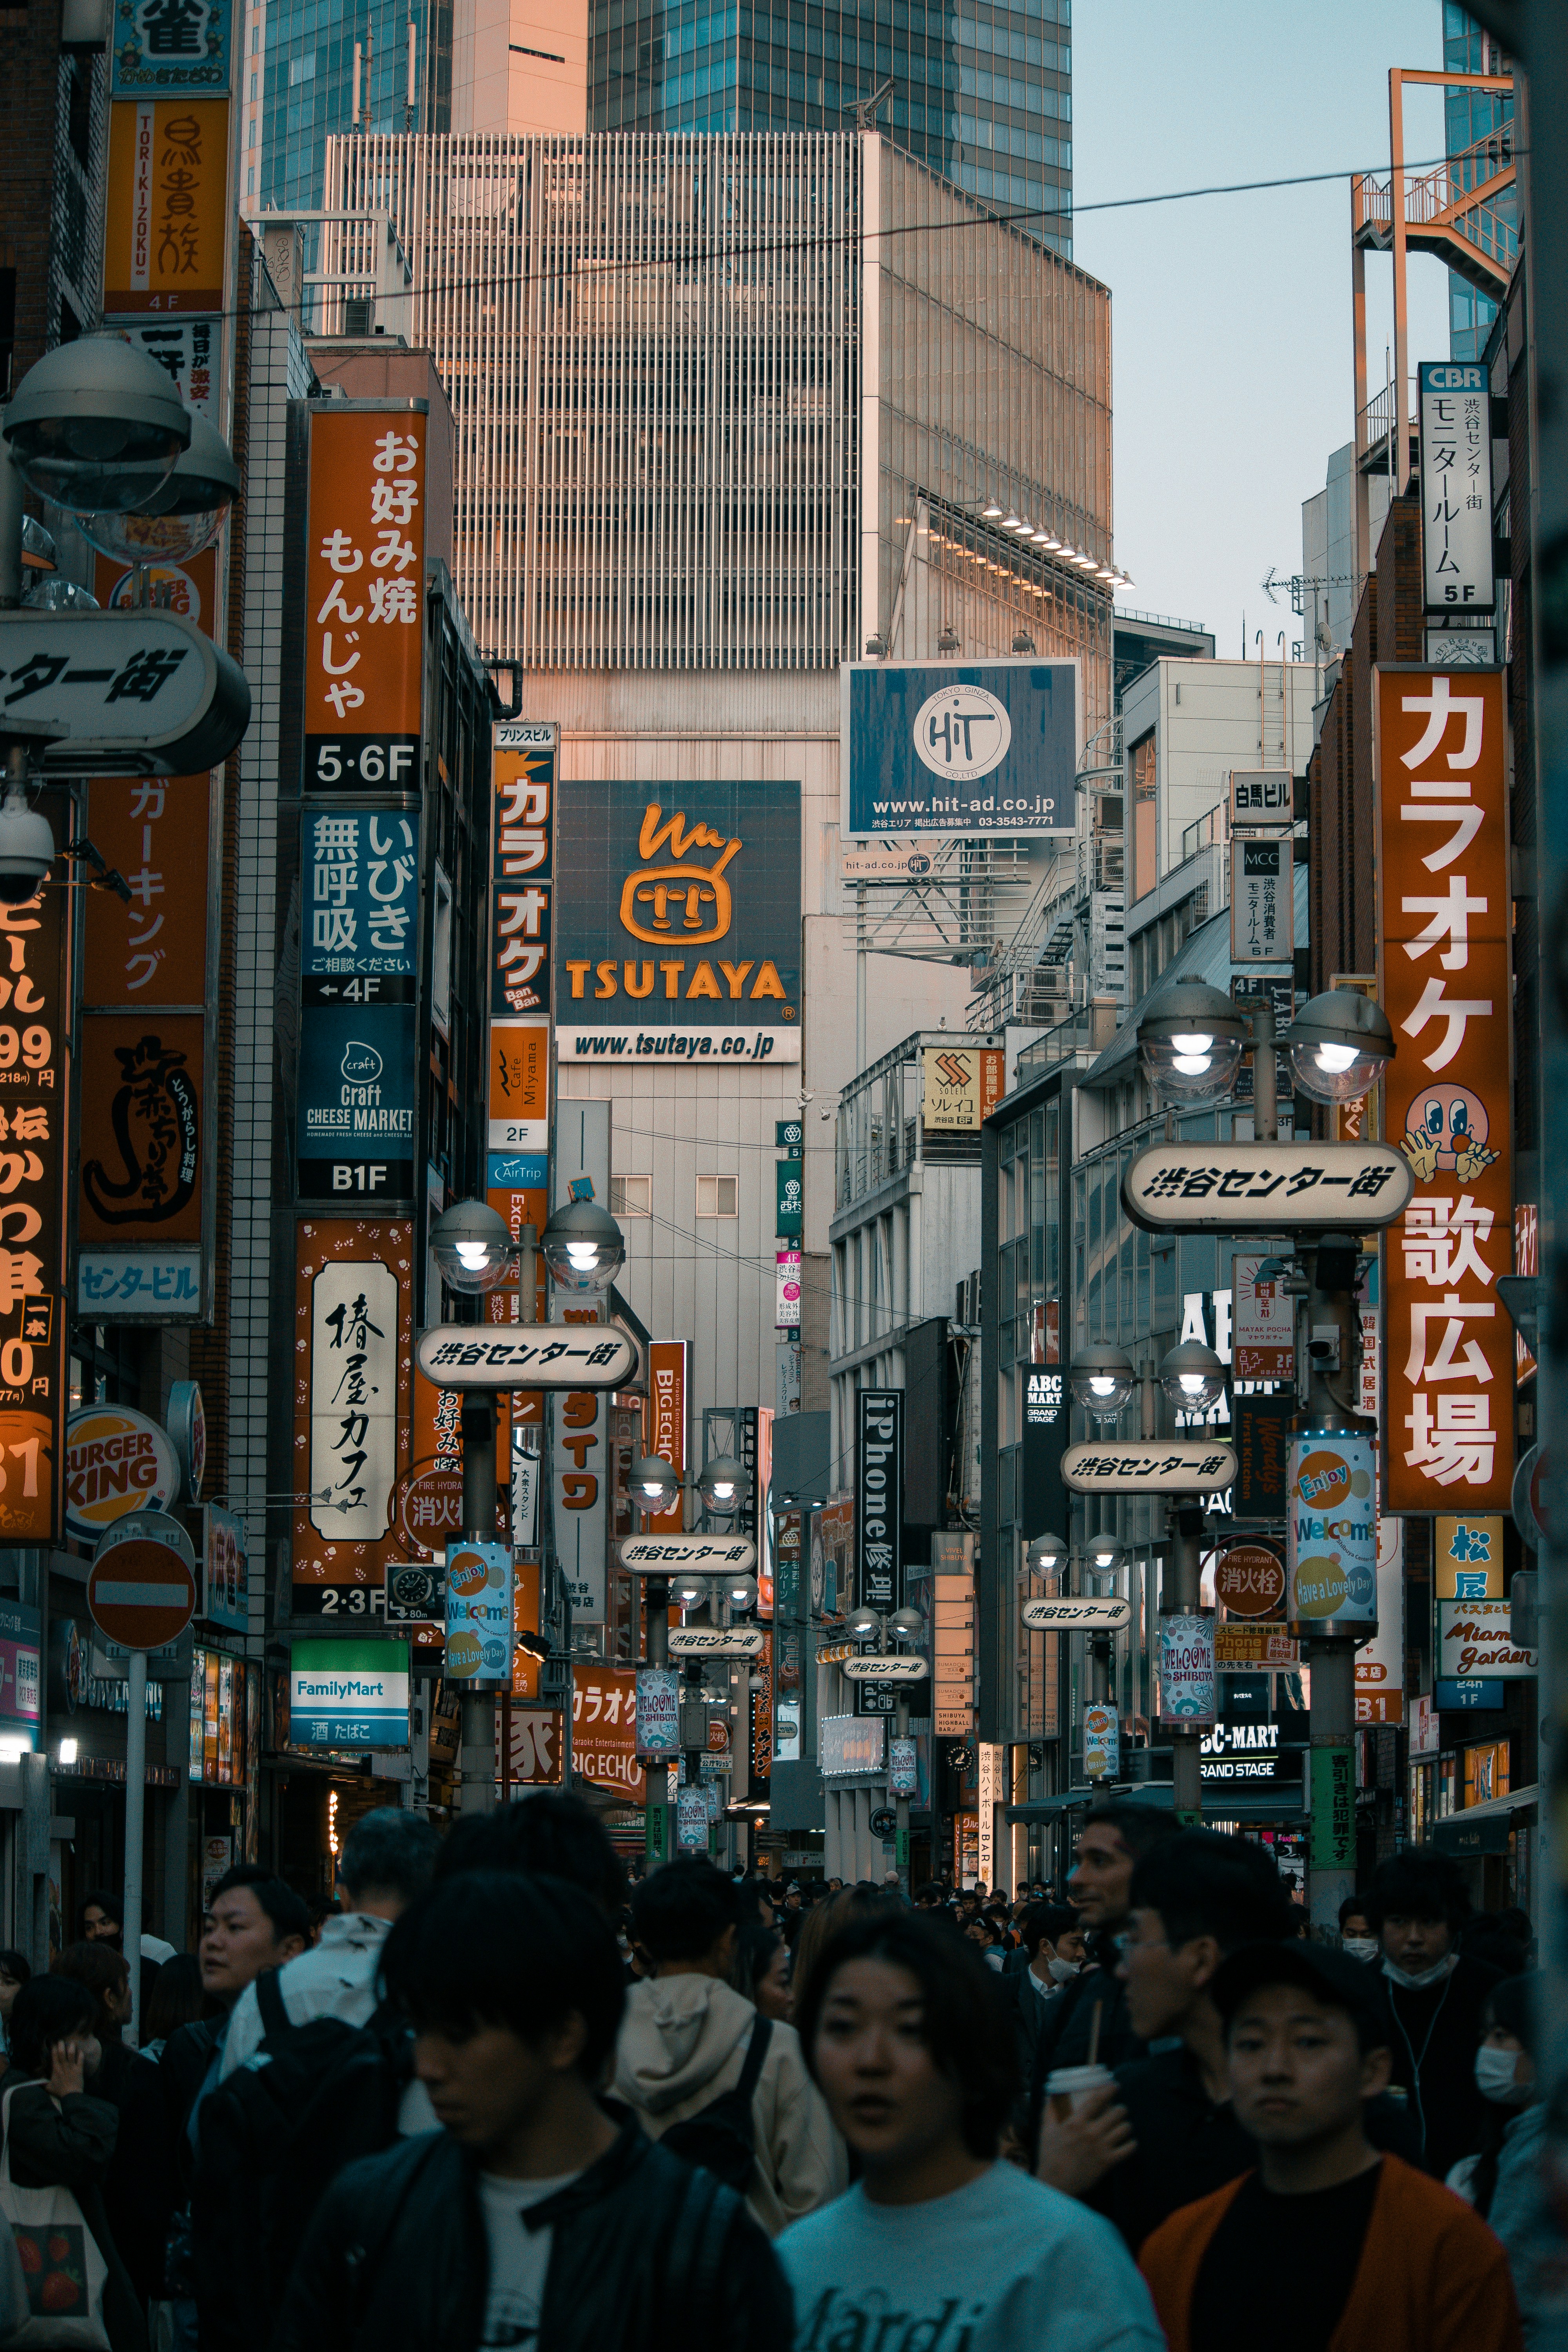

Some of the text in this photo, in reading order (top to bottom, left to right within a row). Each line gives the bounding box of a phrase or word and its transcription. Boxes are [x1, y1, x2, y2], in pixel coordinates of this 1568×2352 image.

[136, 116, 150, 267] TORIKIZOKU
[149, 295, 180, 310] 4F
[1428, 368, 1482, 388] CBR
[1464, 398, 1483, 511] 渋谷センター街
[1431, 399, 1460, 575] モニタールーム
[368, 431, 419, 624] お好み焼
[1444, 585, 1475, 602] 5F
[0, 649, 188, 706] ター街
[932, 686, 990, 702] TOKYO GINZA
[500, 729, 551, 742] プリンスビル
[872, 795, 1056, 813] www.hit-ad.co.jp
[1236, 784, 1290, 808] 白馬ビル
[871, 818, 912, 829] 渋谷エリア
[978, 815, 1054, 827] 03-3543-7771
[846, 860, 907, 871] hit-ad.co.jp
[1245, 853, 1279, 865] MCC
[125, 779, 169, 991] ガーキング
[312, 815, 359, 953] 無呼吸
[367, 815, 415, 951] いびき
[499, 778, 551, 985] カラオケ
[1399, 676, 1493, 1074] カラオケ
[1248, 882, 1260, 944] モニタールーム
[1263, 878, 1276, 940] 渋谷消費者
[1252, 947, 1273, 955] 5F
[311, 957, 410, 973] ご相談ください
[342, 978, 381, 1002] 4F
[566, 960, 787, 999] TSUTAYA
[1235, 979, 1258, 993] 4F
[506, 986, 531, 1001] Ban
[514, 995, 539, 1011] Ban
[575, 1033, 775, 1059] www.tsutaya.co.jp
[347, 1057, 376, 1071] craft
[511, 1058, 521, 1089] Cafe
[524, 1042, 536, 1105] Miyama
[985, 1055, 998, 1105] お部屋探し
[340, 1084, 381, 1106] Craft
[940, 1087, 967, 1095] SOLEIL
[307, 1108, 413, 1131] CHEESE MARKET
[934, 1116, 972, 1125] 渋谷店 6F
[1278, 1118, 1292, 1127] 3F
[171, 1078, 196, 1183] とうがらし料理
[506, 1127, 529, 1142] 2F
[332, 1165, 387, 1191] B1F
[503, 1170, 541, 1183] AirTrip
[1142, 1166, 1396, 1198] 渋谷センター街
[786, 1253, 799, 1263] 4F
[82, 1266, 198, 1300] センタービル
[1401, 1193, 1497, 1487] 歌広場
[430, 1342, 622, 1366] 渋谷センター街
[1276, 1354, 1292, 1368] 2F
[656, 1369, 674, 1409] BIG
[1028, 1375, 1062, 1392] ABC
[325, 1294, 385, 1507] 椿屋カフェ
[1027, 1392, 1062, 1404] MART
[66, 1433, 154, 1475] URGER
[1243, 1412, 1253, 1500] First Kitchen
[1255, 1417, 1282, 1495] Wendy's
[1071, 1456, 1227, 1477] 渋谷センター街
[418, 1481, 463, 1490] FIRE HYDRA
[1298, 1465, 1348, 1500] Enjoy
[521, 1469, 530, 1520] 大衆スタンド
[865, 1397, 895, 1601] iPhone修理
[1294, 1517, 1375, 1542] Welcome
[626, 1546, 748, 1561] 渋谷センター街
[1227, 1555, 1274, 1564] FIRE HYDRANT
[1449, 1525, 1491, 1598] 松屋
[450, 1563, 485, 1589] Enjoy
[1221, 1567, 1279, 1595] 消火栓
[1297, 1577, 1356, 1606] Have a Lovely
[409, 1609, 428, 1619] 80m
[447, 1602, 509, 1621] Welcome
[1027, 1606, 1127, 1619] 渋谷センター街
[670, 1635, 759, 1647] 渋谷センター街
[1215, 1635, 1262, 1647] Phone
[1270, 1636, 1292, 1649] 渋谷
[447, 1649, 460, 1668] Have
[468, 1647, 490, 1664] Lovely
[848, 1662, 923, 1673] 渋谷センター街
[1163, 1647, 1211, 1670] WELCOME
[1172, 1671, 1214, 1682] SHIBUYA
[1356, 1666, 1381, 1679] 本店
[297, 1681, 383, 1699] FamilyMart
[1460, 1694, 1478, 1705] 1F
[639, 1694, 676, 1713] WELCOME
[645, 1713, 678, 1722] SHIBUYA
[1088, 1716, 1108, 1730] Enjoy
[312, 1722, 370, 1741] 酒 たばこ
[1201, 1724, 1279, 1754] BC-MART
[595, 1737, 634, 1749] Entertainment
[599, 1755, 642, 1786] ECHO
[1201, 1762, 1275, 1778] RAND STAGE
[981, 1751, 992, 1862] 渋谷ハイボール BAR
[1332, 1754, 1350, 1861] 客引きは犯罪です
